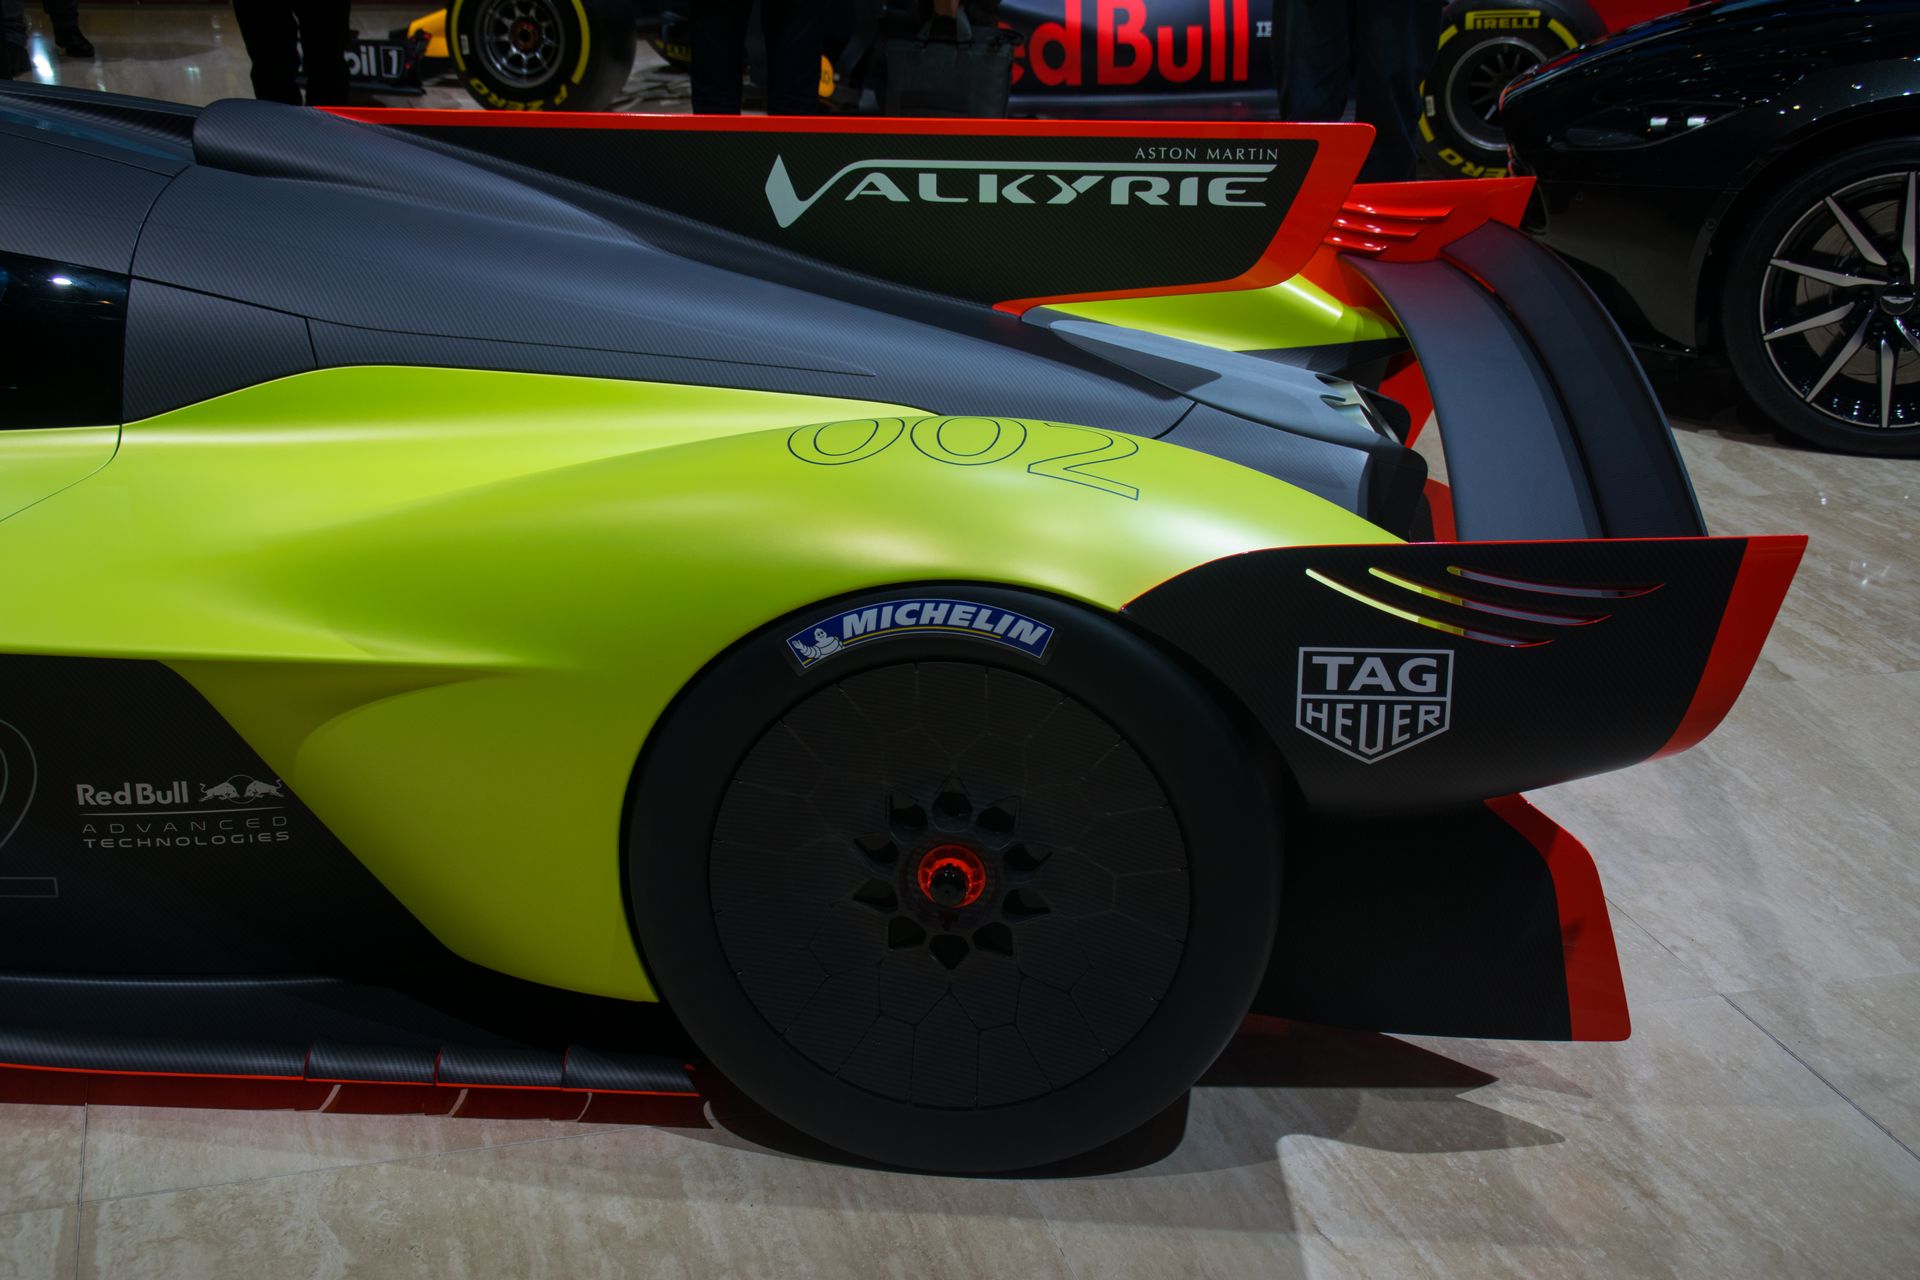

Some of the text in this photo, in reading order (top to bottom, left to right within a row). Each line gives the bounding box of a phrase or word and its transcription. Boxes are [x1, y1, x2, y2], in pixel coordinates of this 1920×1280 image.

[1465, 9, 1541, 30] PIRELLI
[1096, 0, 1249, 85] Bull
[1135, 146, 1278, 161] ASTON MARTIN
[1438, 147, 1507, 178] ERO
[765, 154, 1277, 228] VALKYRIE
[787, 416, 1140, 501] 002
[842, 602, 1047, 647] MICHELIN
[1312, 655, 1437, 693] TAG
[1305, 702, 1441, 755] HEUER
[76, 781, 189, 806] Red Bull
[82, 816, 288, 834] ADVANCED
[83, 831, 290, 849] TECHNOLOGIES
